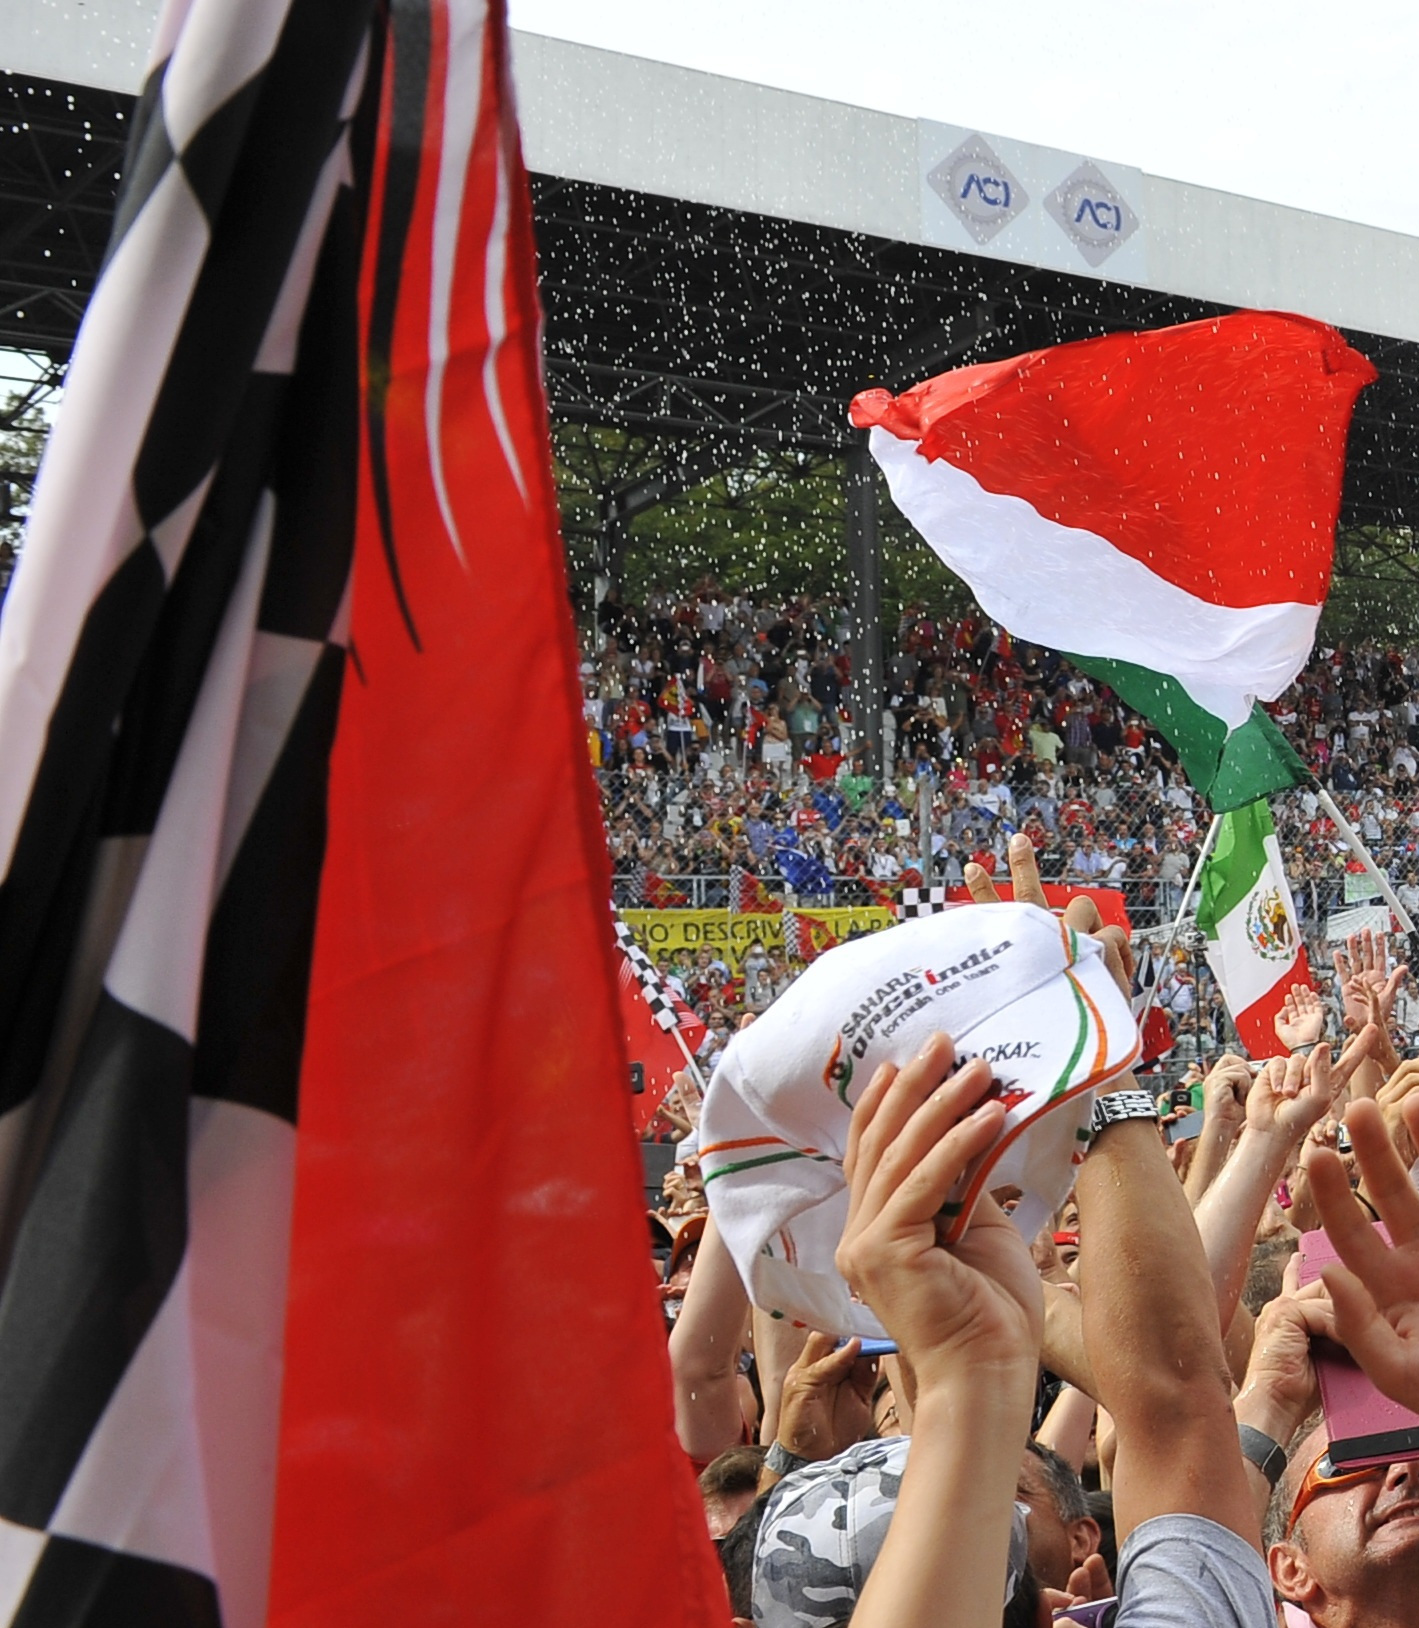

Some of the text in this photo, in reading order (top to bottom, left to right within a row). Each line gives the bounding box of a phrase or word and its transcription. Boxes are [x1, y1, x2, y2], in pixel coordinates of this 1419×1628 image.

[960, 173, 1011, 208] ACI
[1074, 198, 1122, 231] ACI
[683, 920, 784, 942] DESCRIV
[924, 940, 1014, 986] india
[841, 971, 919, 1039] SAHARA
[881, 963, 1000, 1039] formula one team
[952, 1041, 1040, 1074] MCKAY
